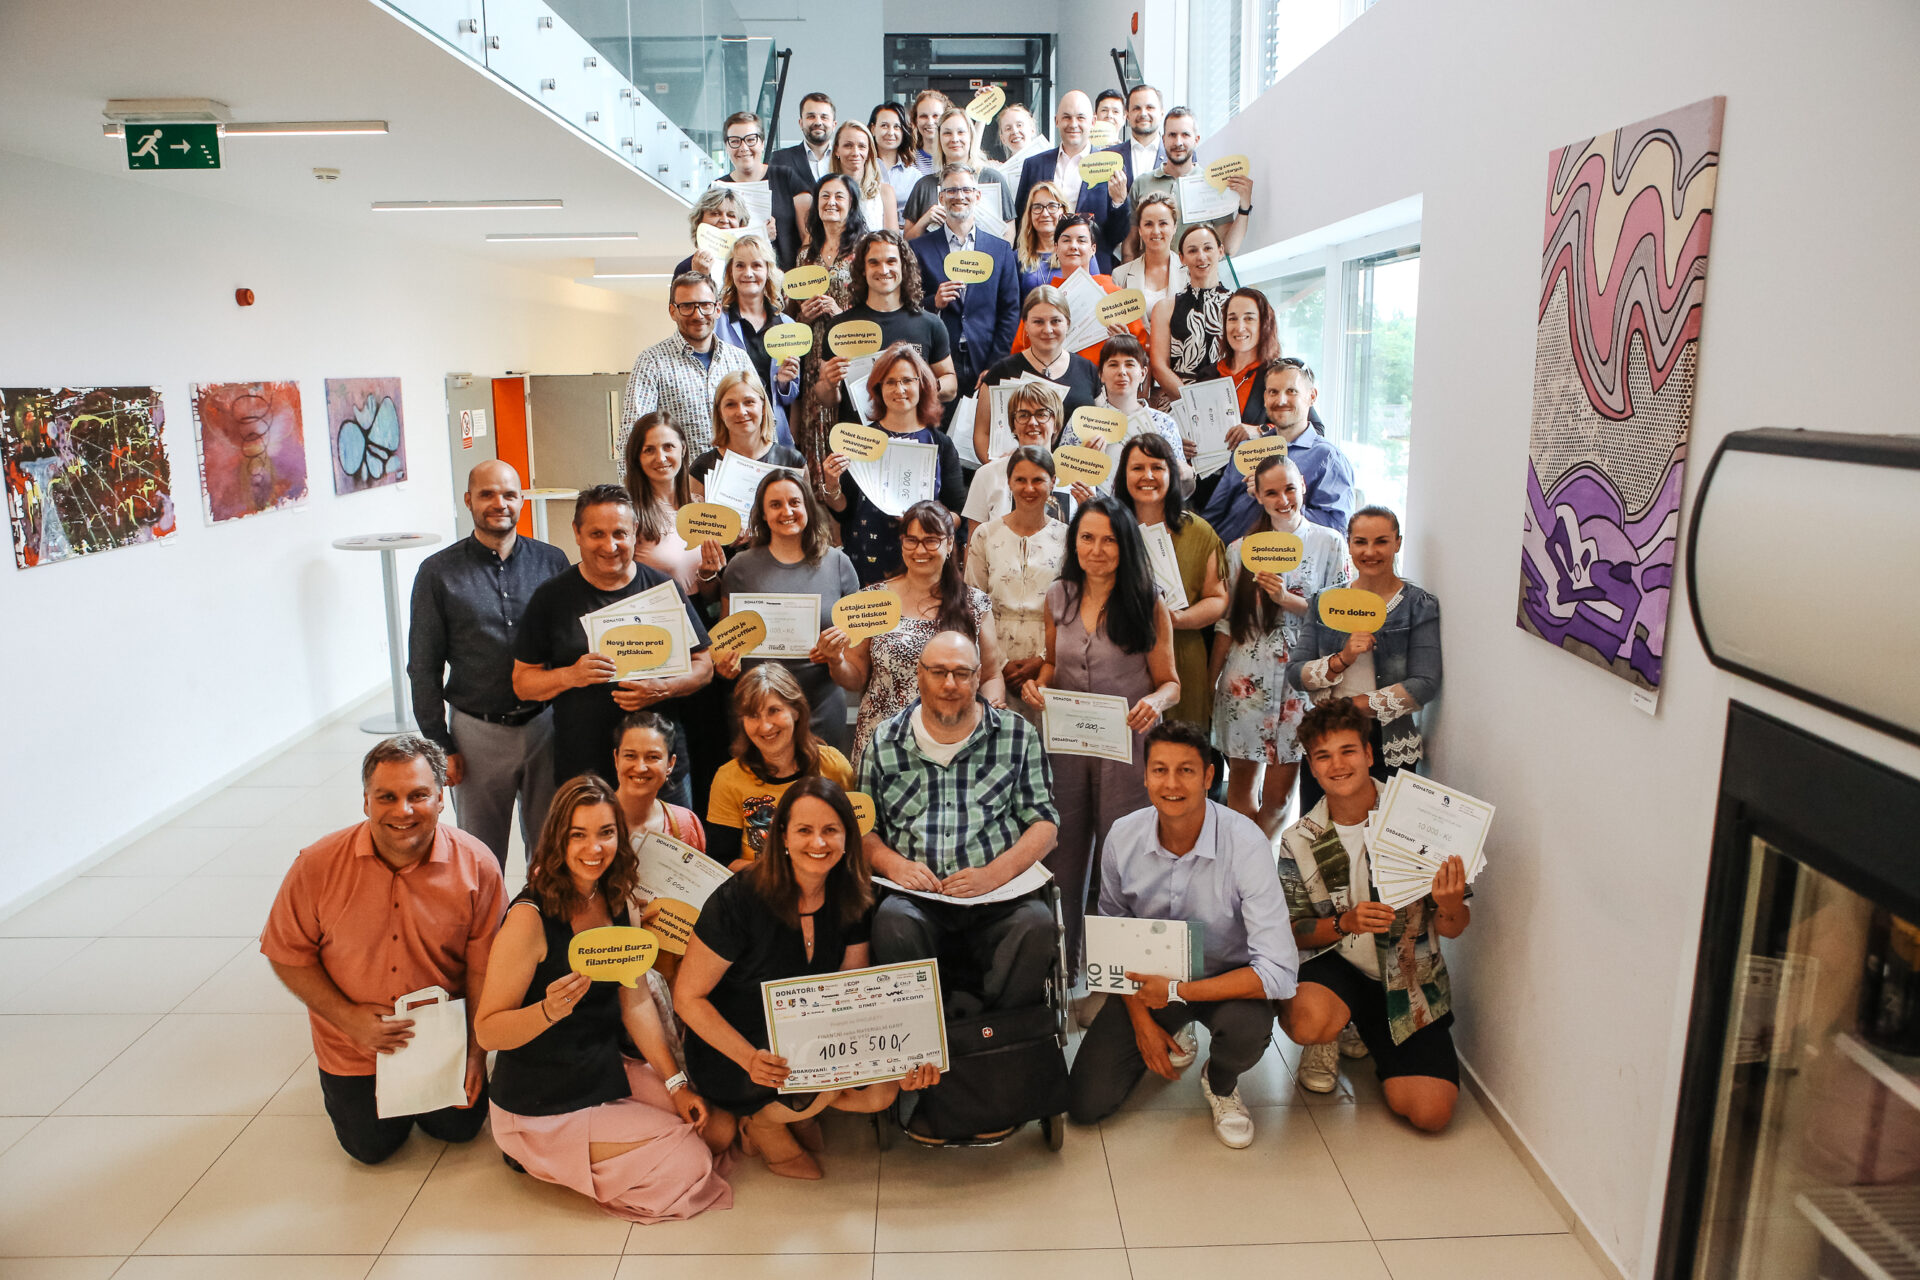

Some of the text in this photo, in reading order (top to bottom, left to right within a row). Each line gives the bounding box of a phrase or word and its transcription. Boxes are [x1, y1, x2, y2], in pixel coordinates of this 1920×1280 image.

[952, 267, 986, 276] filantropie
[808, 276, 827, 285] smysl
[856, 435, 880, 445] baterky
[1238, 448, 1266, 456] Sportuje
[700, 512, 716, 520] Nové
[867, 600, 892, 608] zvedák
[1328, 607, 1376, 617] Pro dobro
[847, 614, 860, 622] pro
[716, 625, 740, 640] Příroda
[714, 636, 737, 651] nejlepší
[737, 626, 757, 638] offline
[660, 907, 674, 917] Nová
[658, 917, 678, 930] učebna
[578, 945, 622, 954] Rekordní
[586, 954, 644, 966] filantropie!!!
[1088, 963, 1102, 988] KO
[820, 1041, 858, 1060] 1005
